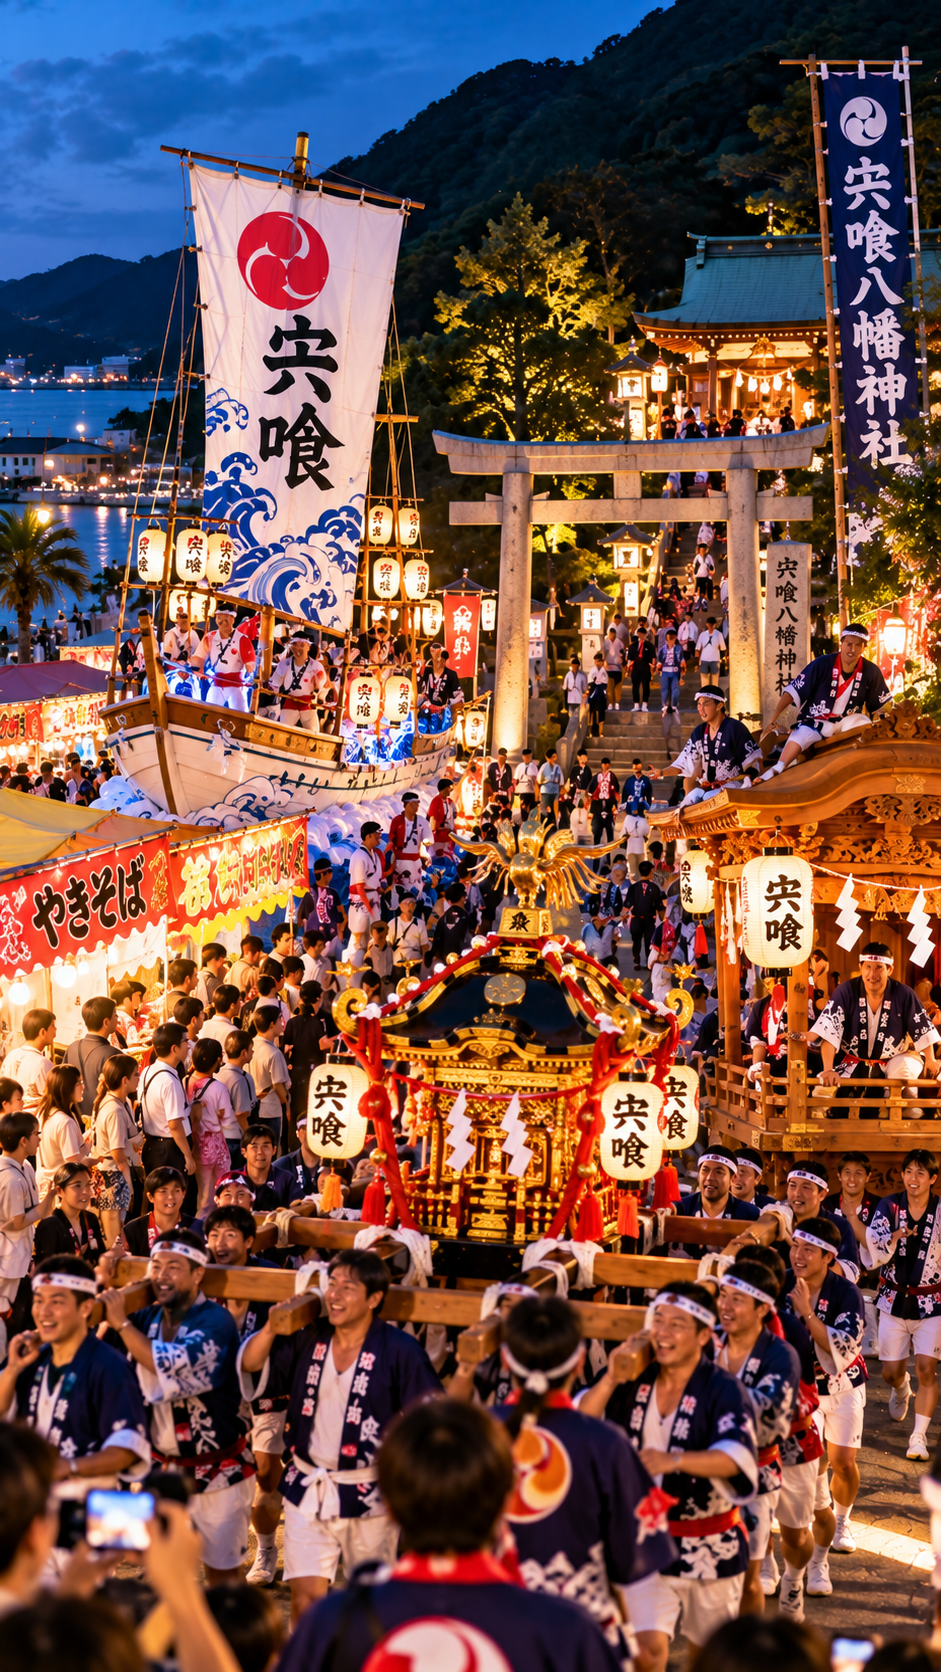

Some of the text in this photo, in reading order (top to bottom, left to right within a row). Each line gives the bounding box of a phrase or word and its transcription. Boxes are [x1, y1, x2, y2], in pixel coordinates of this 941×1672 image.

[843, 156, 914, 470] 宍喰八幡神社
[258, 314, 345, 491] 宍喰
[32, 853, 147, 949] やきそば
[764, 873, 804, 951] 宍喰
[312, 1075, 347, 1147] 宍喰
[611, 1093, 650, 1169] 宍喰
